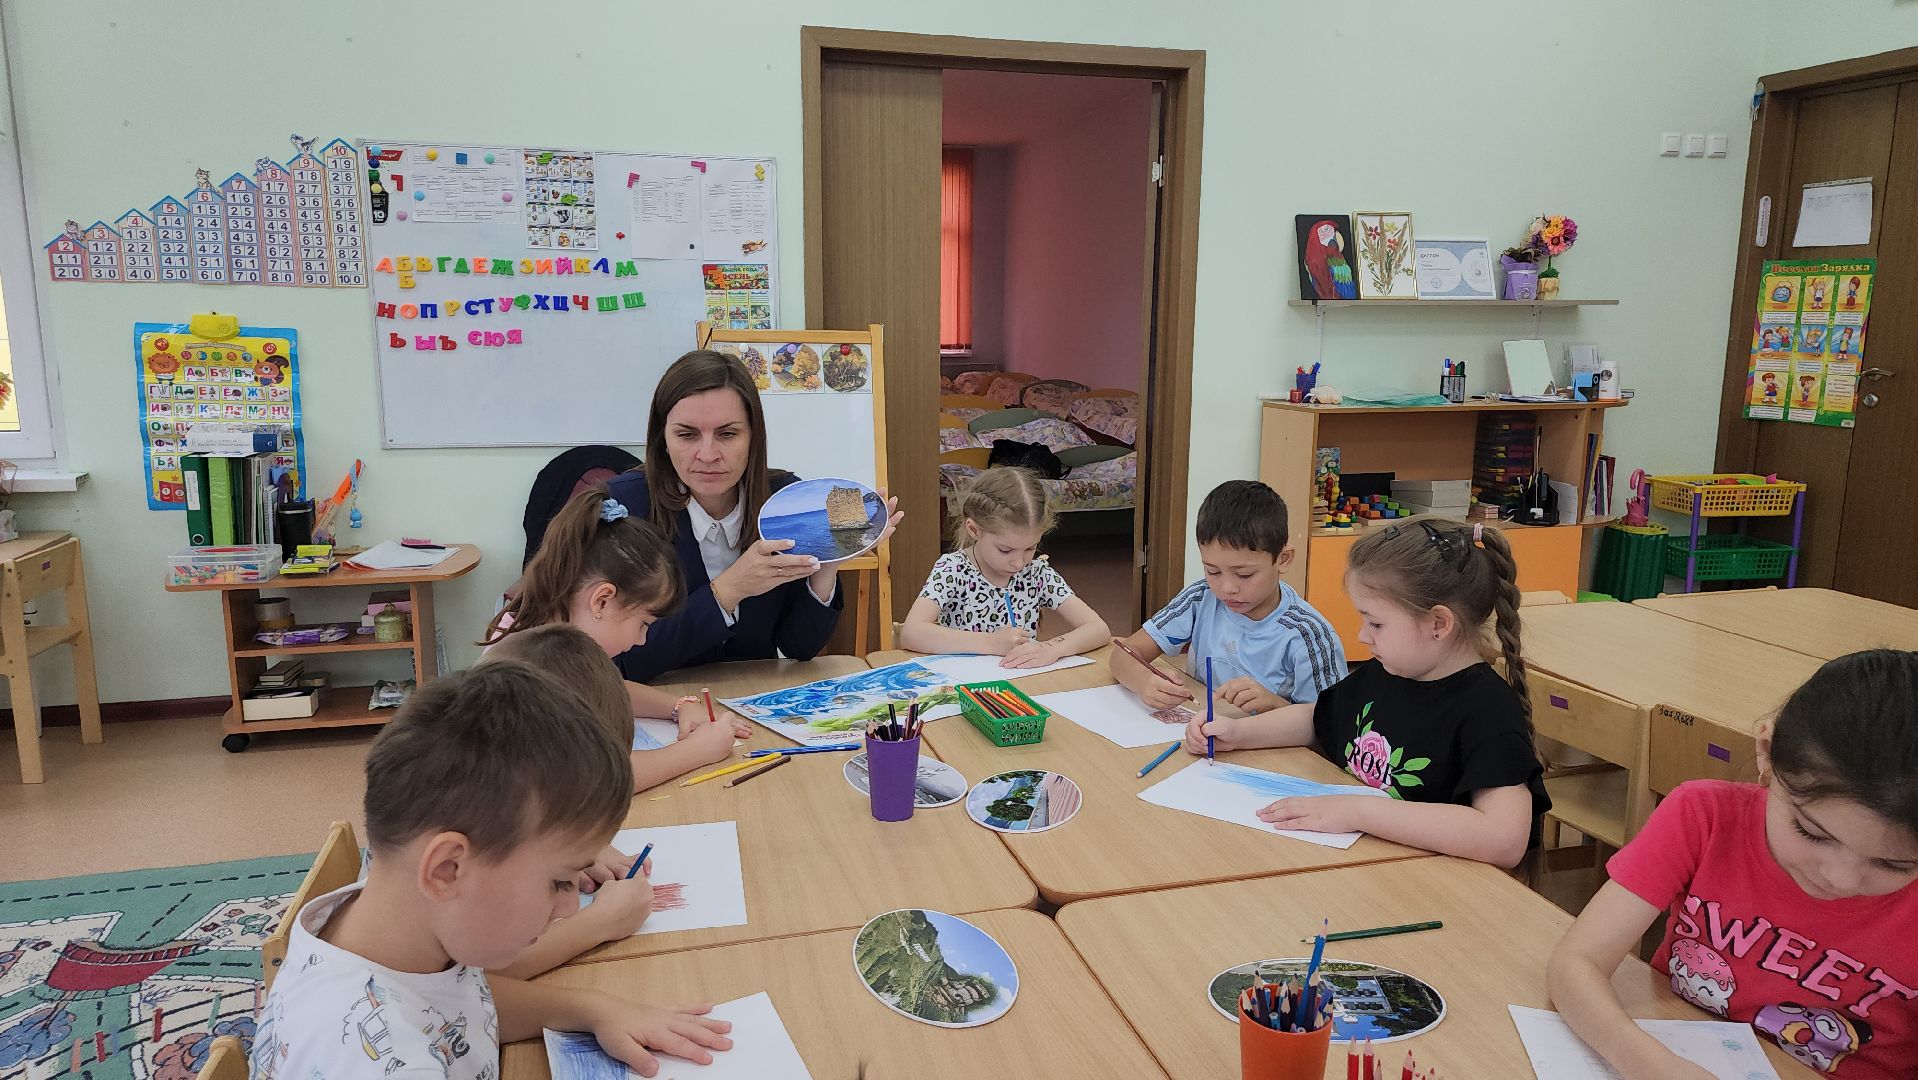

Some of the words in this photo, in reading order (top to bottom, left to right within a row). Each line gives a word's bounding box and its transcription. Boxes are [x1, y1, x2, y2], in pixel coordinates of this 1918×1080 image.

[333, 146, 346, 155] 10
[303, 159, 309, 168] 9
[271, 170, 277, 178] 8
[236, 181, 242, 189] 7
[202, 193, 208, 201] 6
[166, 204, 173, 212] 5
[132, 218, 138, 226] 4
[98, 230, 104, 239] 3
[63, 242, 70, 250] 2
[150, 386, 156, 394] Г
[175, 386, 183, 395] Д
[224, 388, 230, 396] Ё
[152, 422, 161, 430] О
[1674, 894, 1918, 1018] SWEET
